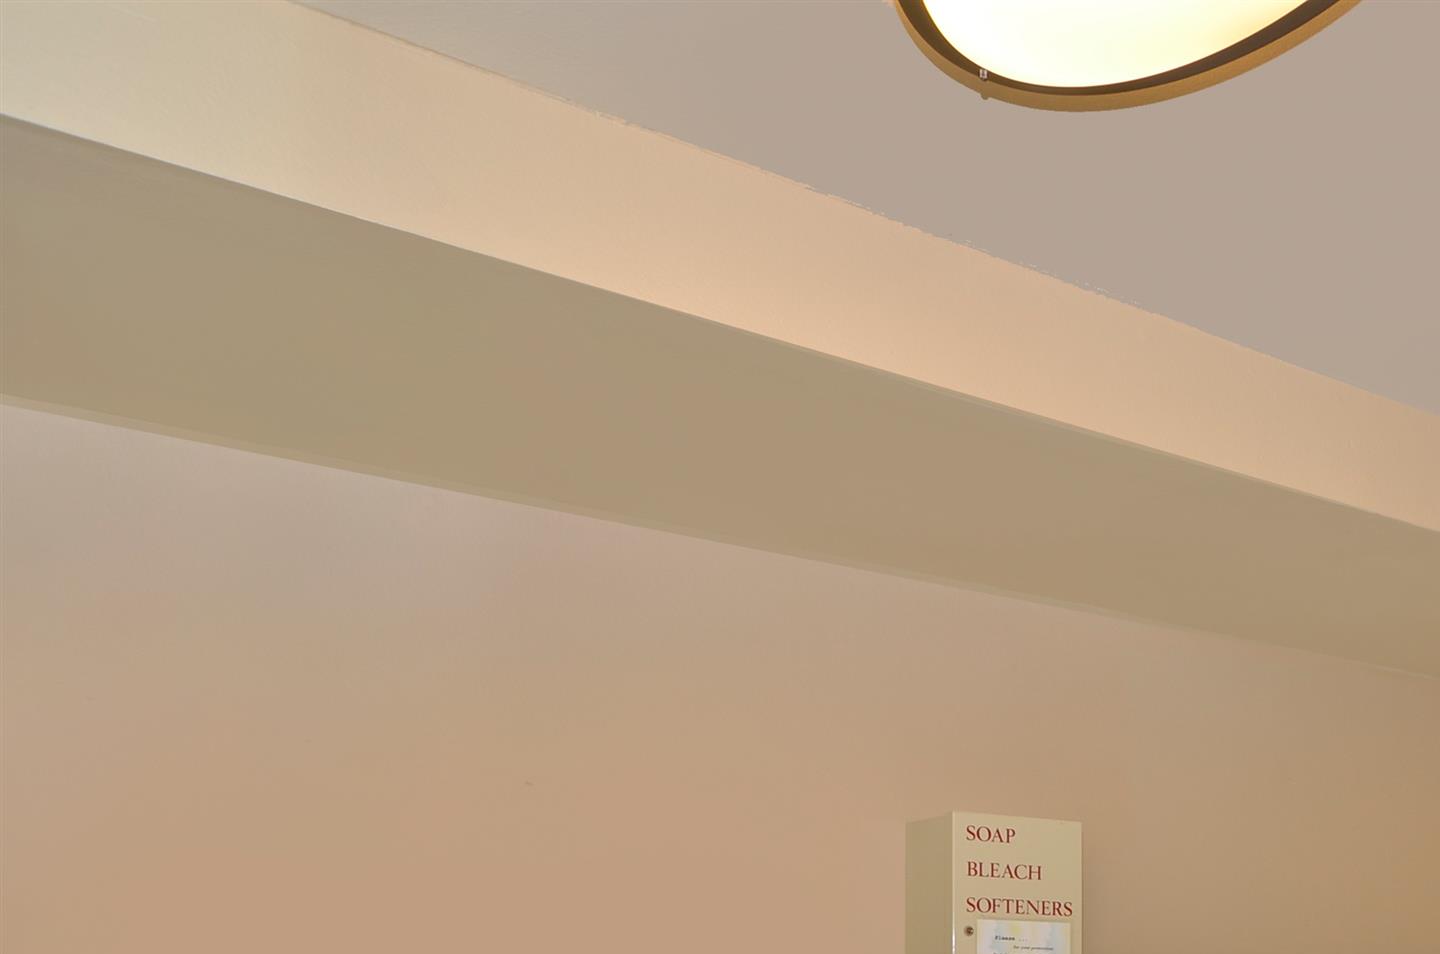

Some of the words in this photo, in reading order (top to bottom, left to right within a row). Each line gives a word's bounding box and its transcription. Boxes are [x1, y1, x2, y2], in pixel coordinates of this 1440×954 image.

[966, 825, 1016, 844] SOAP
[967, 861, 1042, 880] BLEACH
[966, 897, 1073, 917] SOFTENERS
